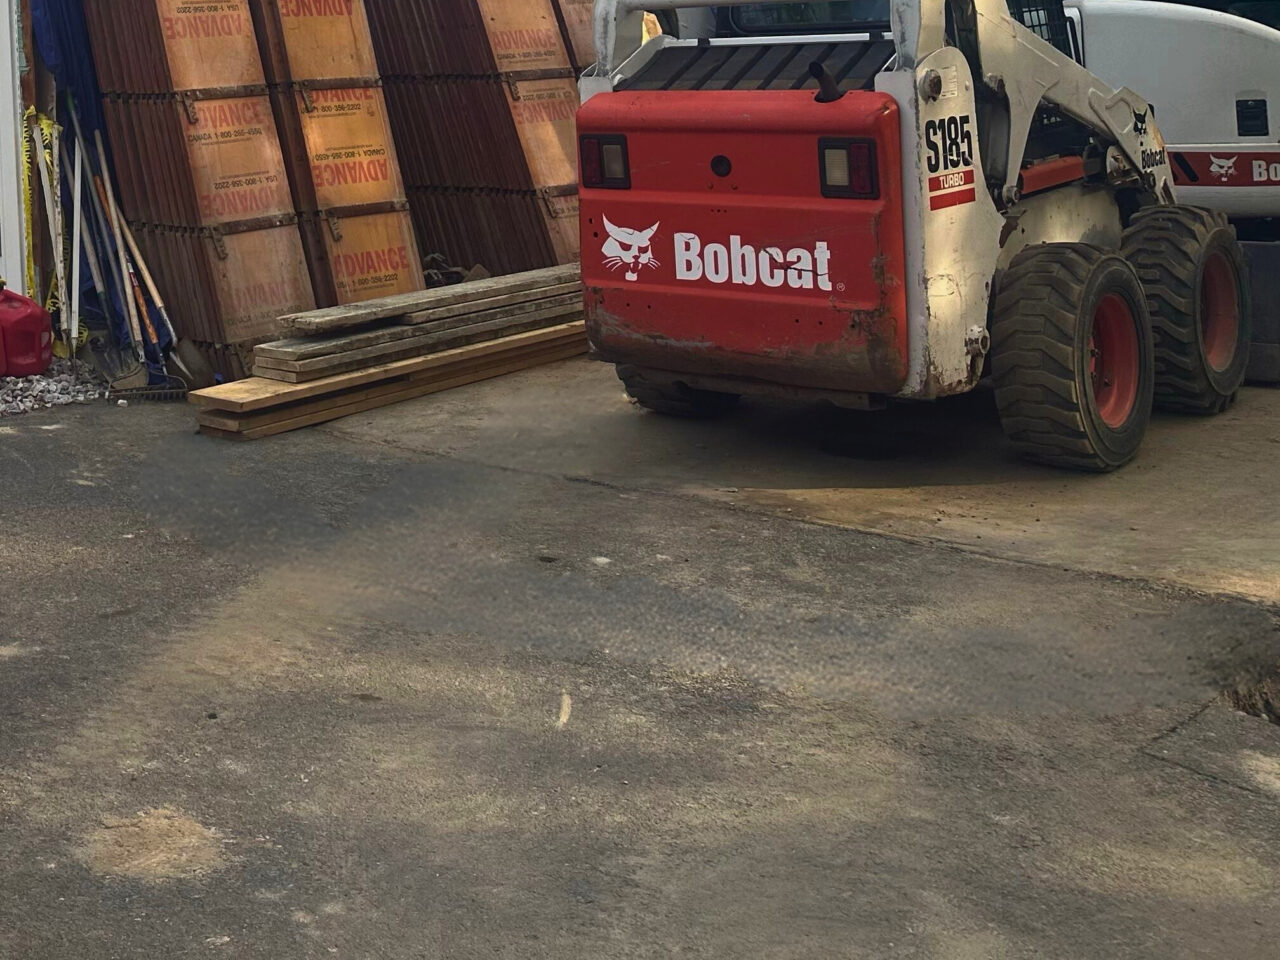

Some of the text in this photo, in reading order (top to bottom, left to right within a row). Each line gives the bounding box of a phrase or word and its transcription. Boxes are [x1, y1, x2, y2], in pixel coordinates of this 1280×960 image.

[163, 14, 242, 40] ADVANCE
[492, 29, 557, 51] ADVANCE
[363, 148, 385, 158] CANADA
[925, 114, 973, 173] S185
[1141, 146, 1166, 169] Bobcat
[312, 159, 389, 188] ADVANCE
[939, 172, 965, 189] TURBO
[334, 246, 409, 278] ADVANCE
[673, 231, 833, 291] Bobcat
